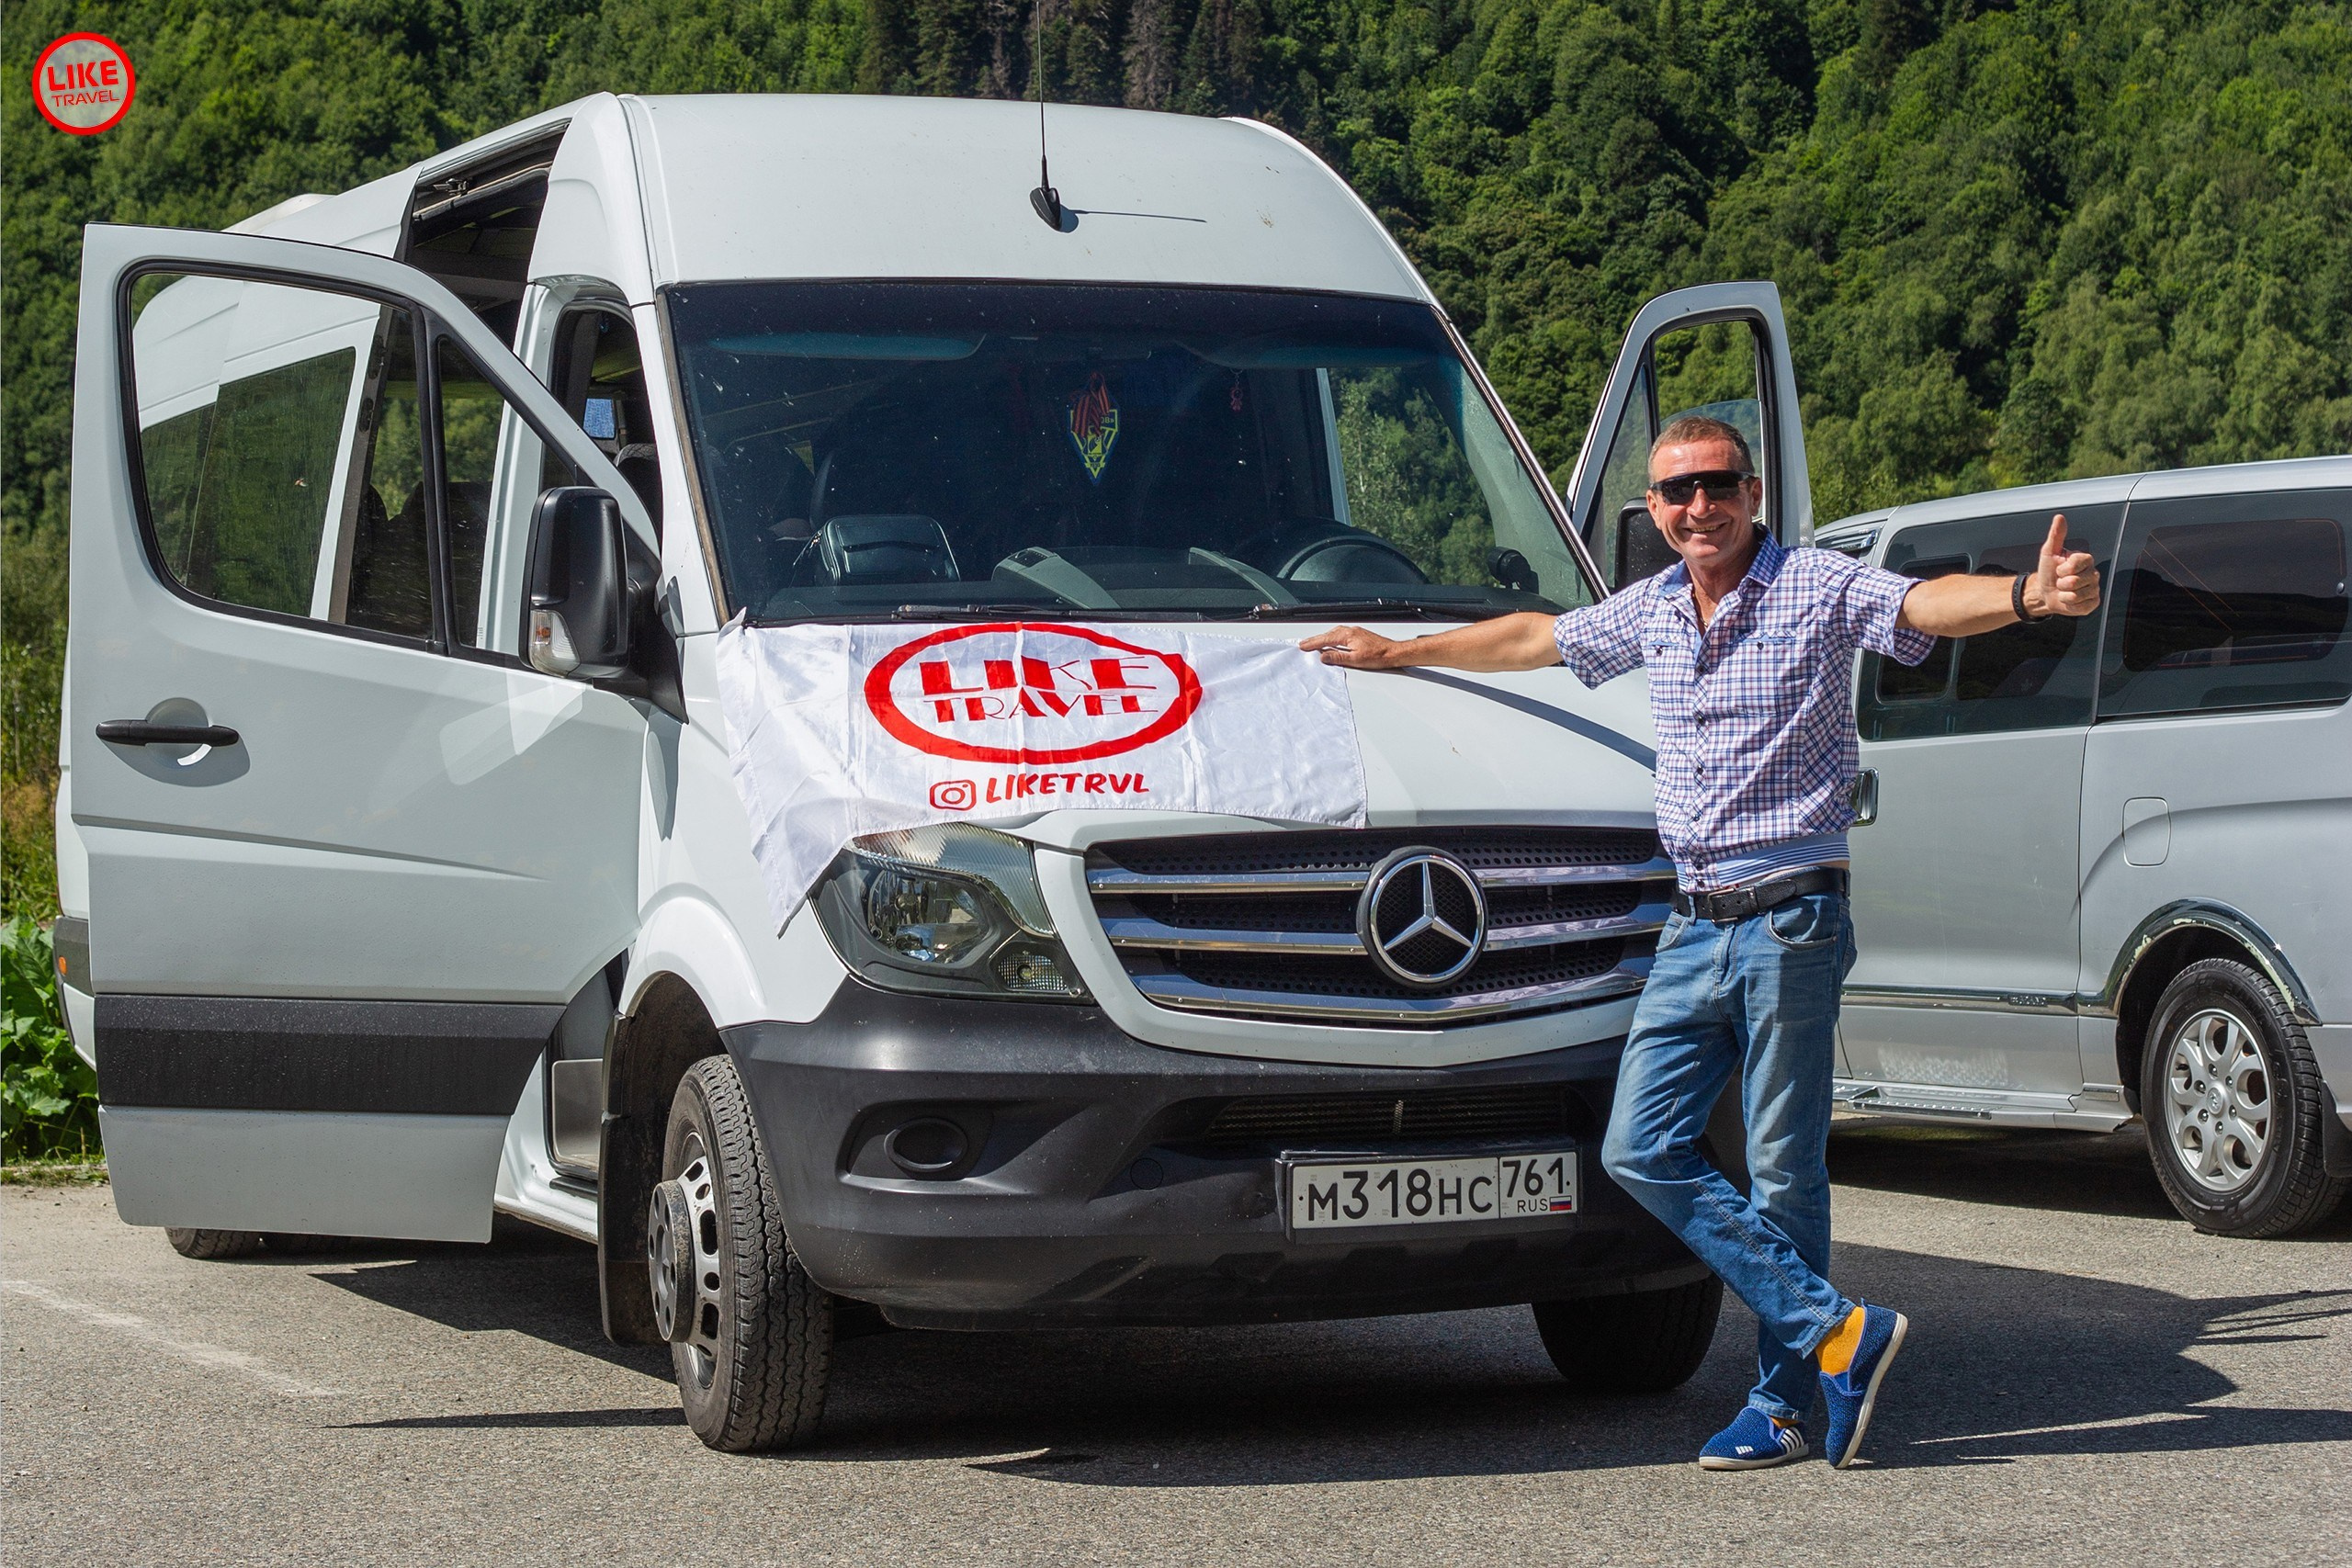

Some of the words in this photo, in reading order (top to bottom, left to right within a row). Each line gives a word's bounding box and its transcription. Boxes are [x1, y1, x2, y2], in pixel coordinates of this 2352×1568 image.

[919, 655, 1157, 696] LIKE
[923, 687, 1159, 723] TRAVEL
[985, 773, 1150, 804] LIKETRVL
[1502, 1157, 1564, 1198] 761
[1517, 1198, 1548, 1213] RUS
